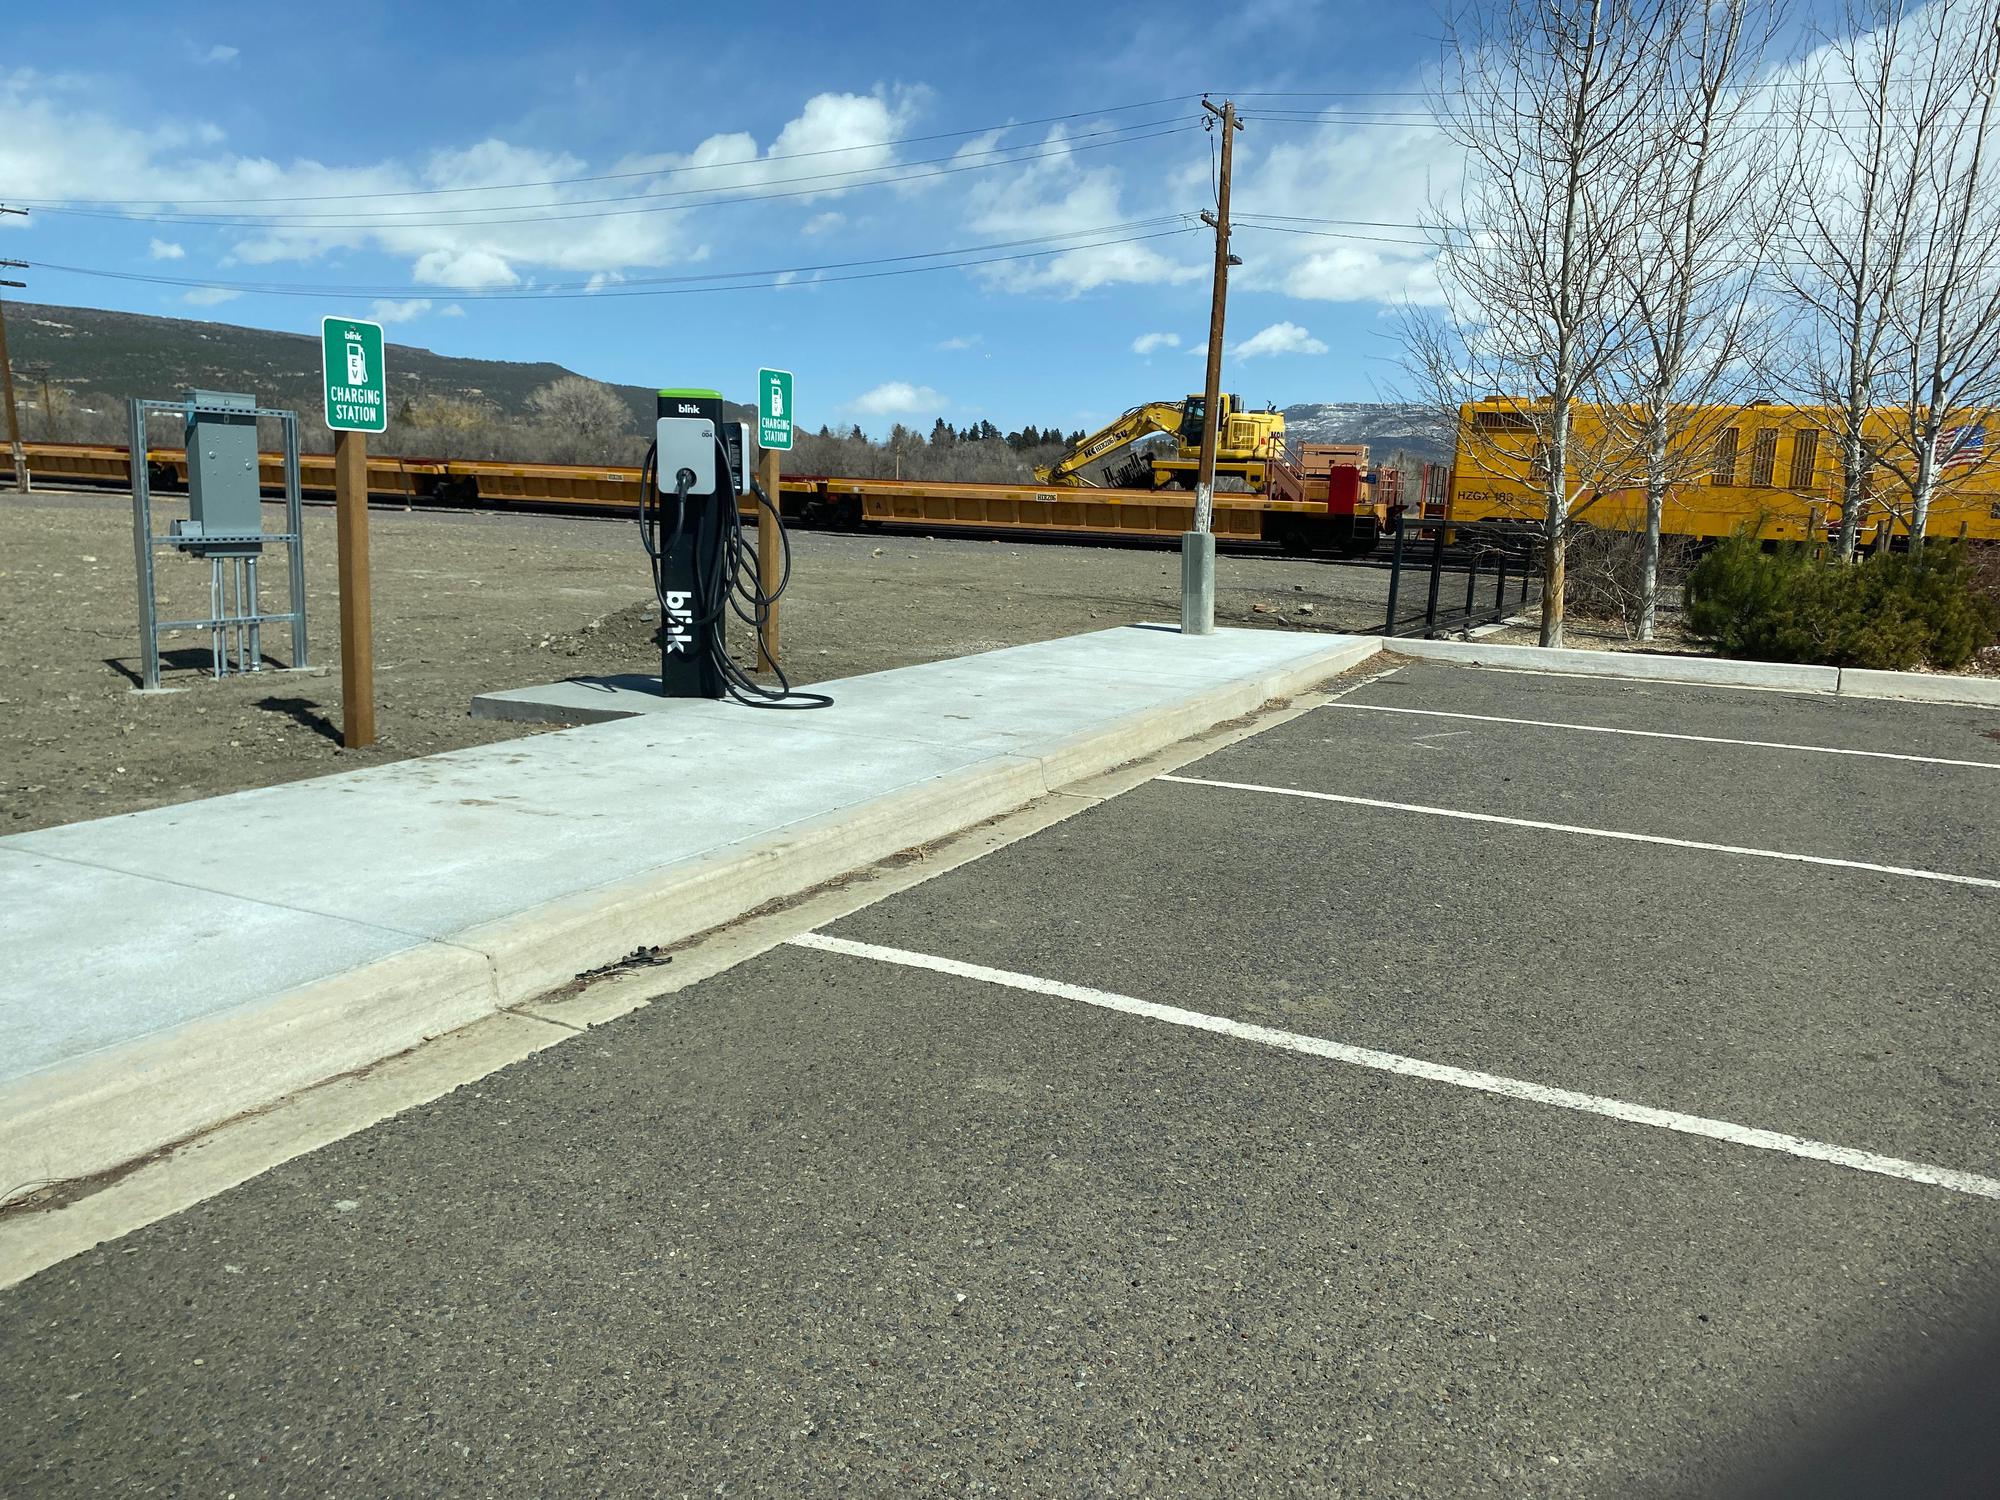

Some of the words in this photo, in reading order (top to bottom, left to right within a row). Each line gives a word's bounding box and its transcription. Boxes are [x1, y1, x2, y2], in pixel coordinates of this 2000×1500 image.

[344, 330, 362, 341] blink
[330, 386, 380, 405] CHARGING
[336, 404, 376, 422] STATION
[678, 403, 700, 414] blink
[761, 417, 790, 431] CHARGING
[764, 430, 787, 442] STATION
[1457, 491, 1489, 501] HZGX
[666, 591, 693, 654] blink
